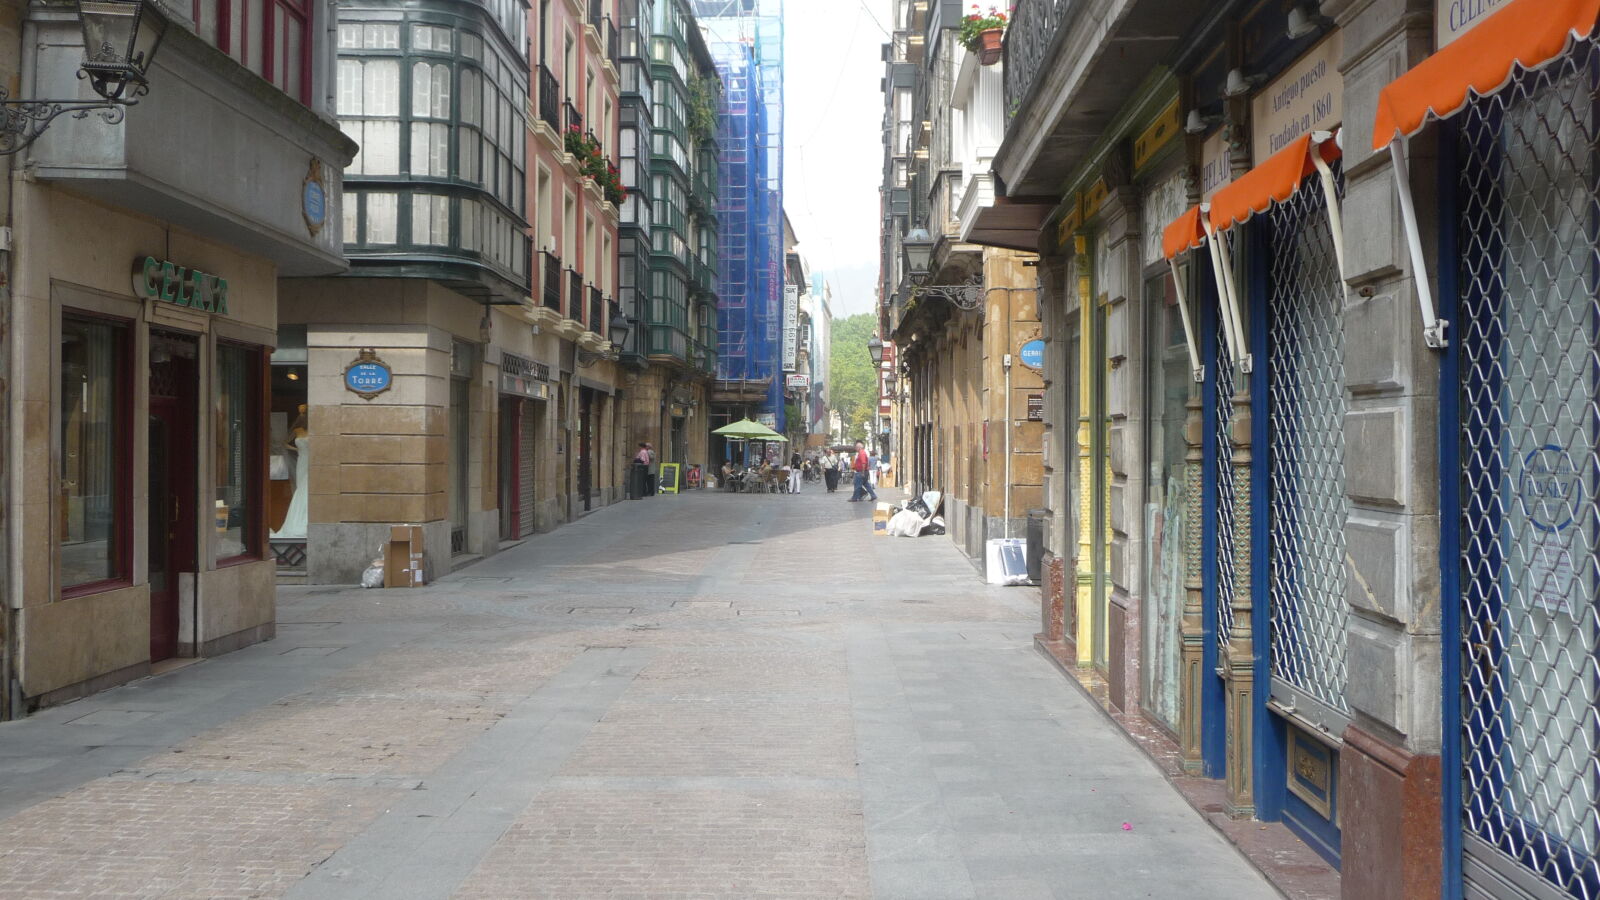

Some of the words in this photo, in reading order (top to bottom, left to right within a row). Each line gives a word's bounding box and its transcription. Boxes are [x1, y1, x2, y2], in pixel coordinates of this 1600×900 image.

[1273, 82, 1299, 112] Antiguo
[1300, 60, 1326, 98] puesto
[1269, 118, 1300, 154] Fundado
[1301, 113, 1310, 132] en
[1312, 92, 1332, 125] 1860
[143, 256, 229, 315] CELAYA
[789, 300, 797, 310] 02
[789, 313, 796, 324] 42
[788, 327, 796, 343] 499
[788, 346, 795, 358] 94
[352, 376, 383, 384] TORRE
